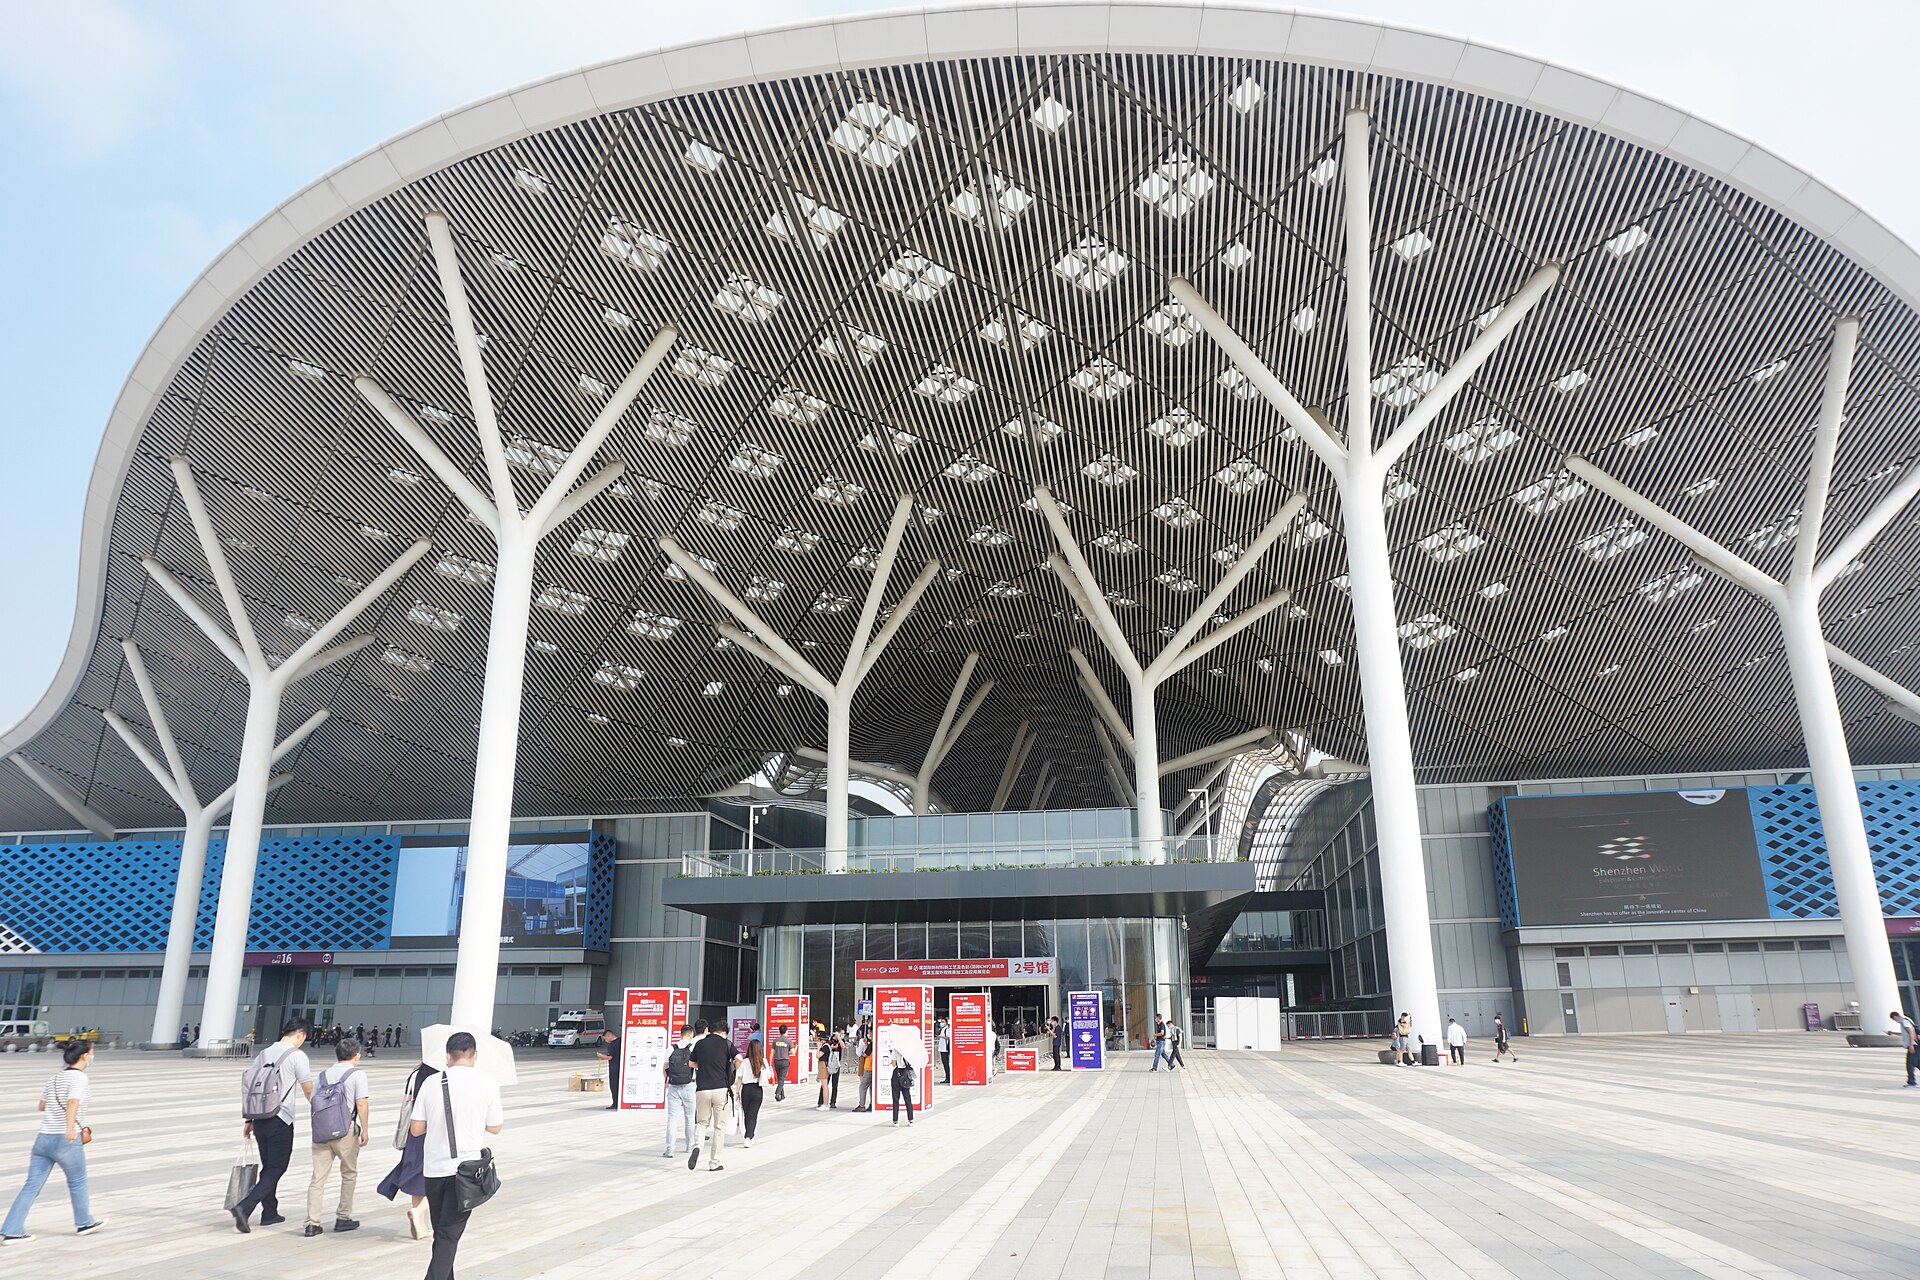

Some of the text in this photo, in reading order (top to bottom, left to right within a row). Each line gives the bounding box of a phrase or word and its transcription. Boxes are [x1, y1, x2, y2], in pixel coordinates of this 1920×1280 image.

[1593, 865, 1647, 877] Shenzhen
[281, 953, 292, 963] 16
[1014, 961, 1049, 974] 2号馆
